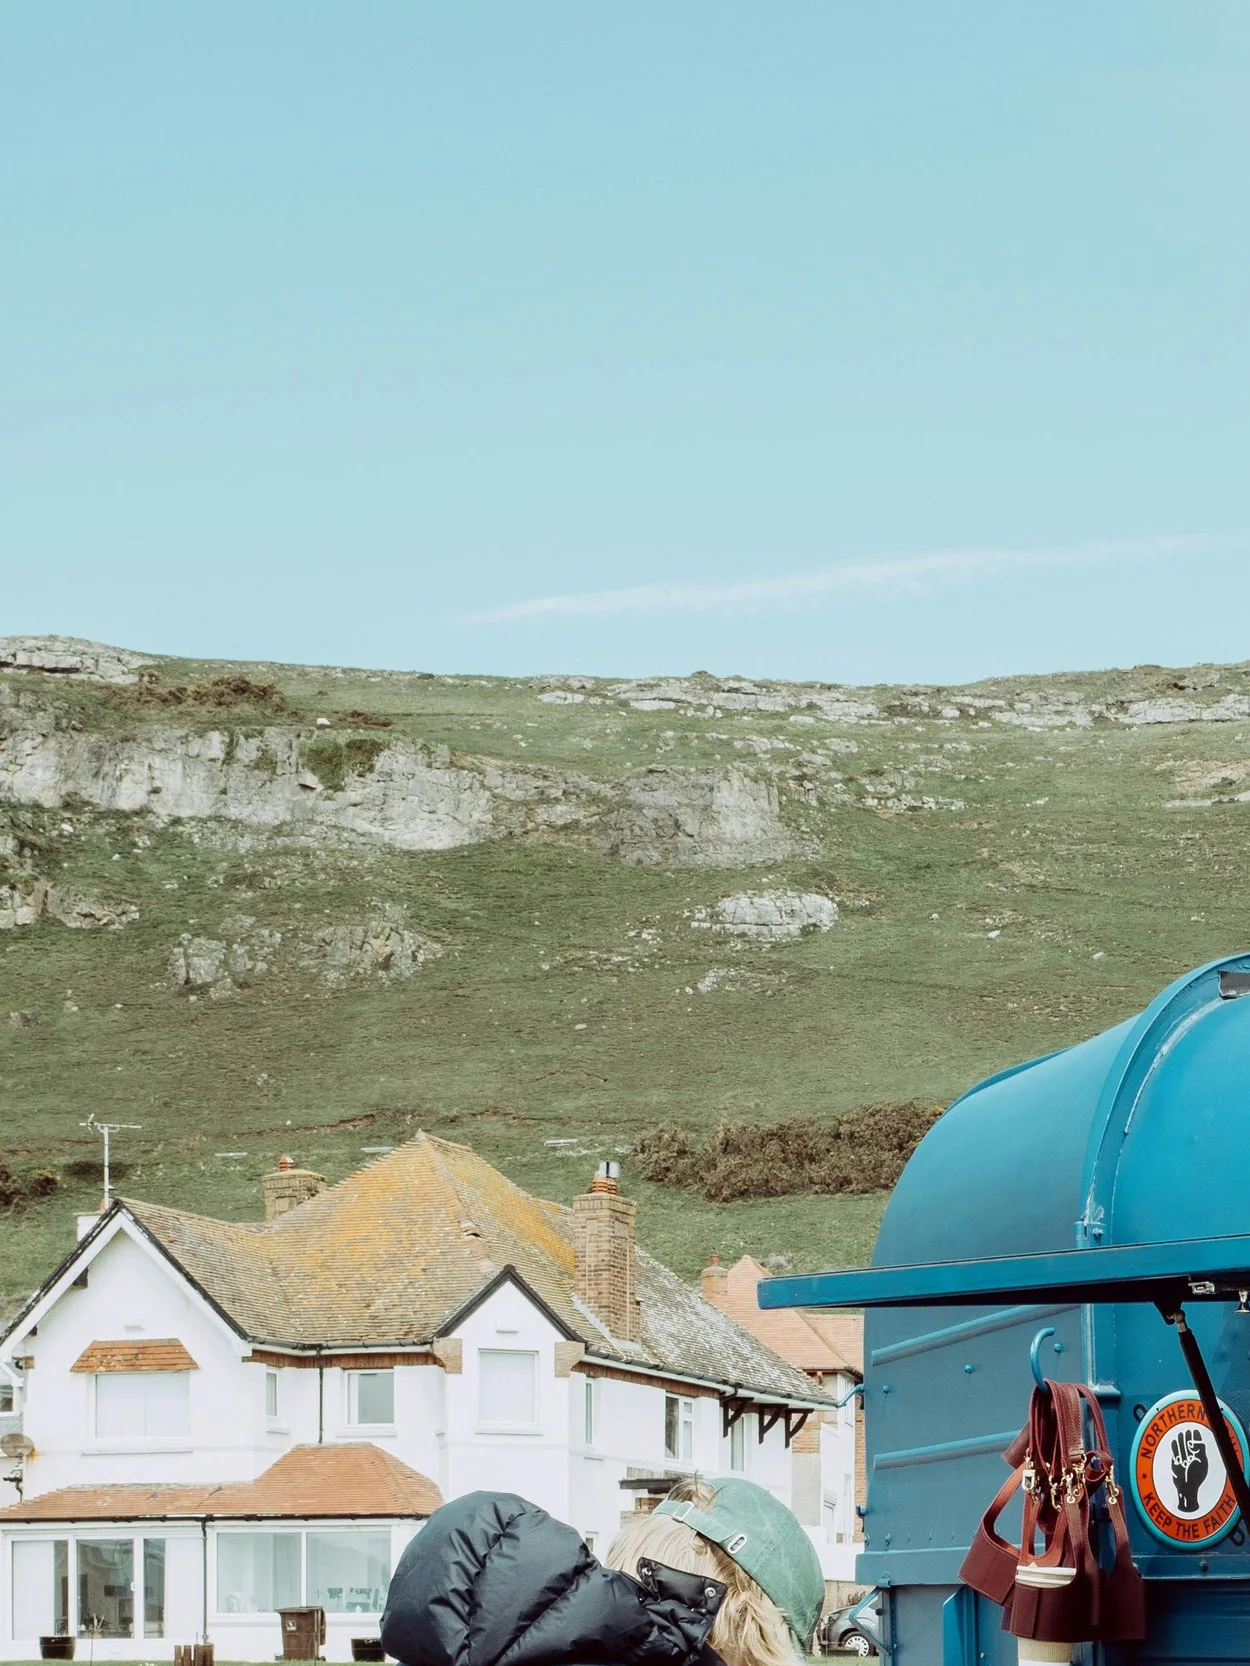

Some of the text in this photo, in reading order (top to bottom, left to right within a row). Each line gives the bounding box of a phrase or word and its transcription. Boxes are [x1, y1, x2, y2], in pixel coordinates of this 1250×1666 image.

[1143, 1491, 1237, 1539] KEEP THE FAITH
